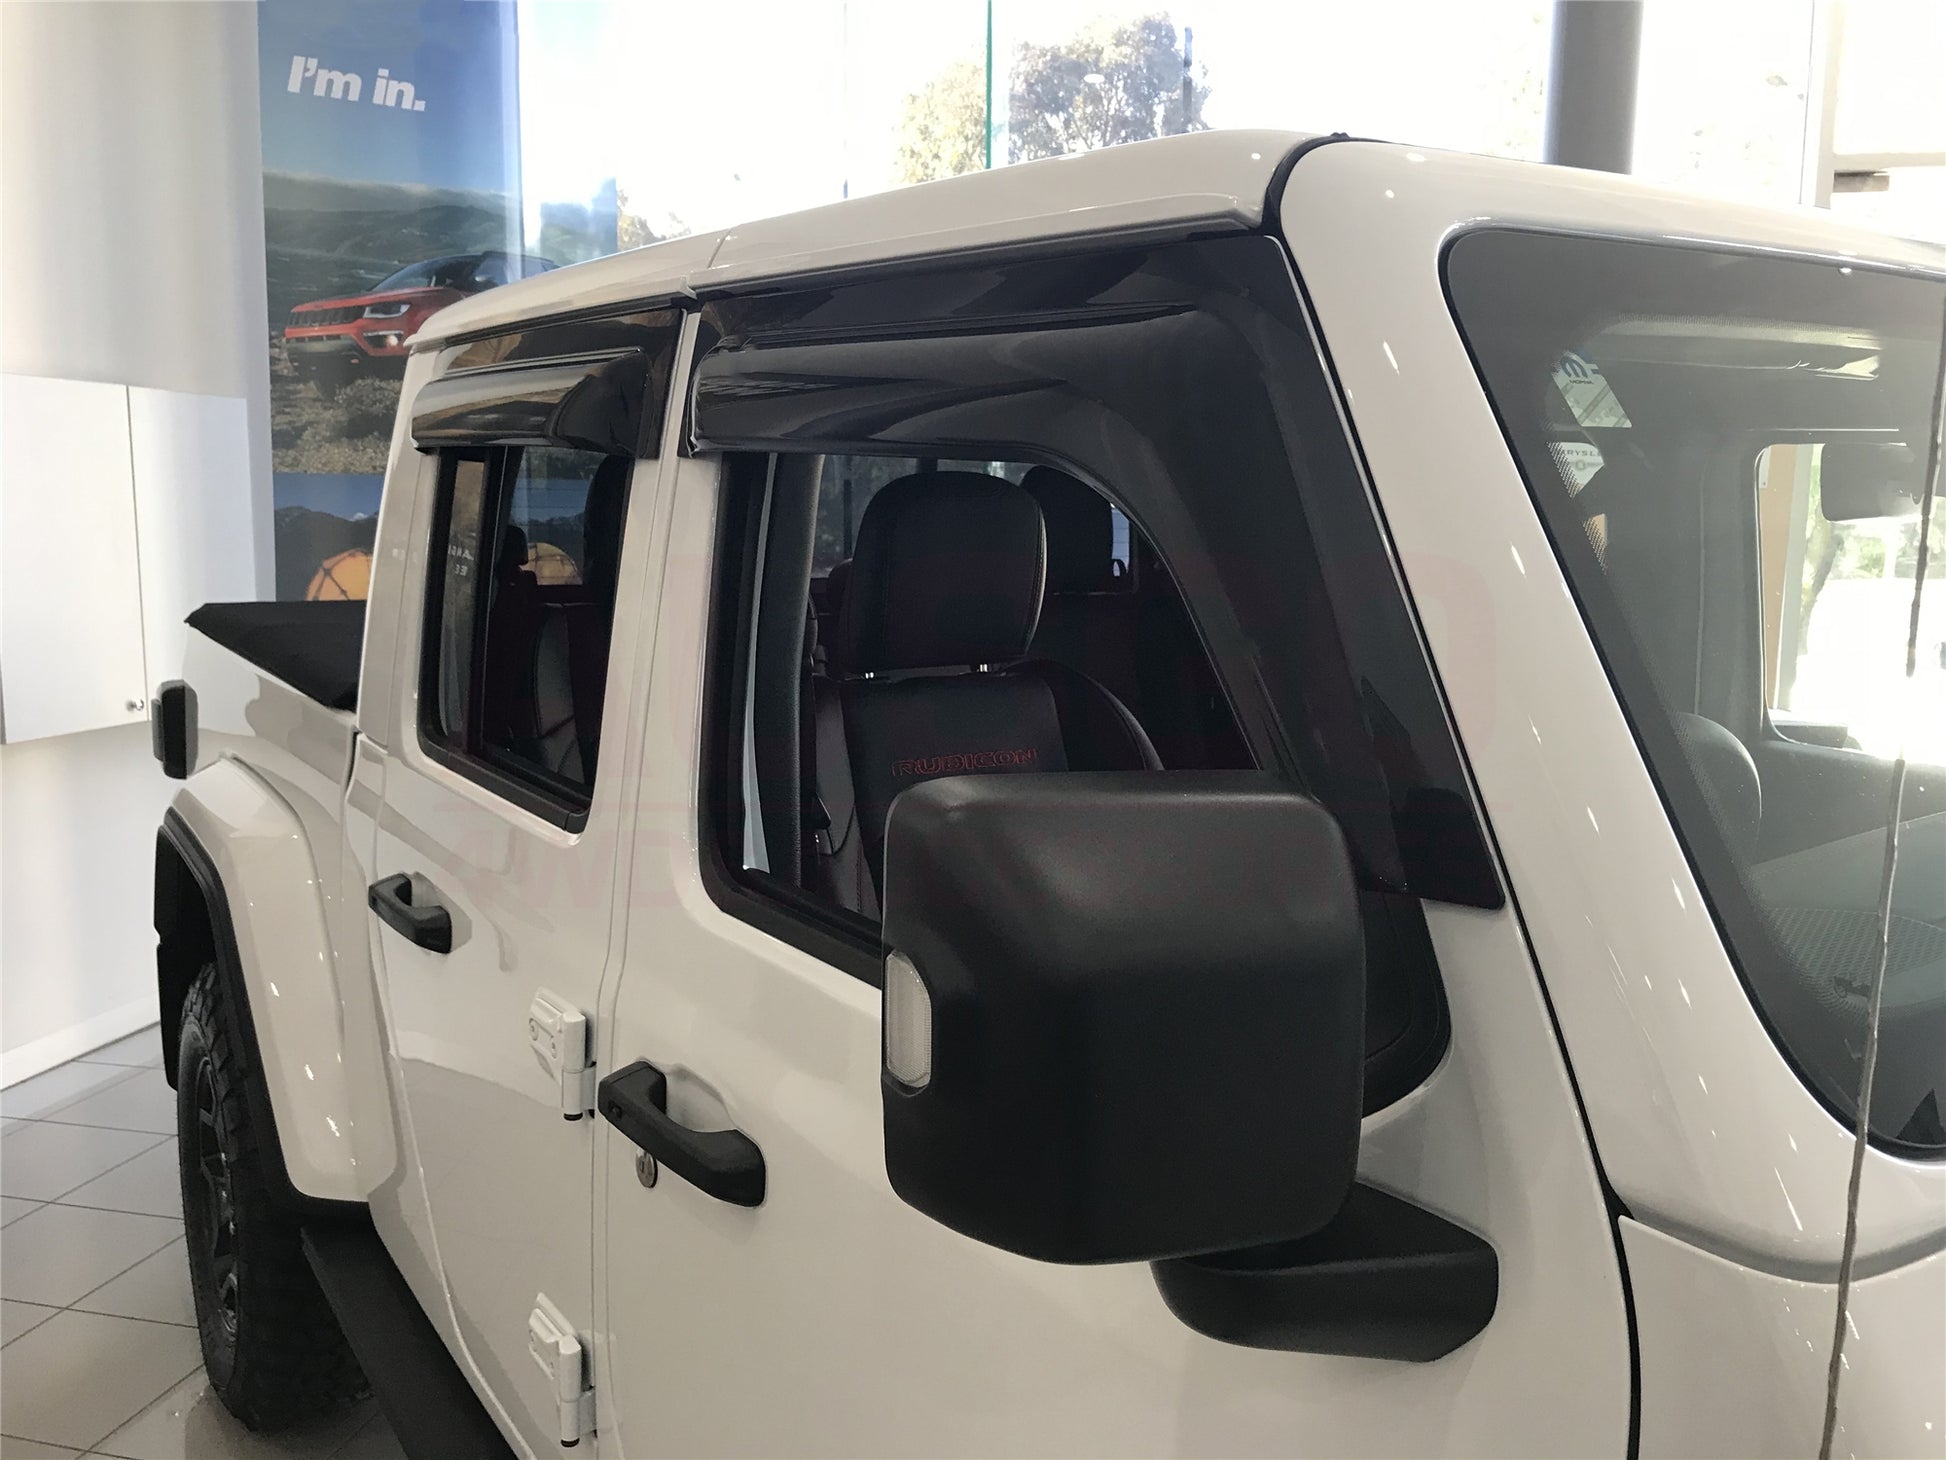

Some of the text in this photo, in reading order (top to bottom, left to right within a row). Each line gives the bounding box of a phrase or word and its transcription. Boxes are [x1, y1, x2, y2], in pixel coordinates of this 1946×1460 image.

[287, 55, 426, 112] I'm in.
[891, 748, 1038, 777] RUBICON
